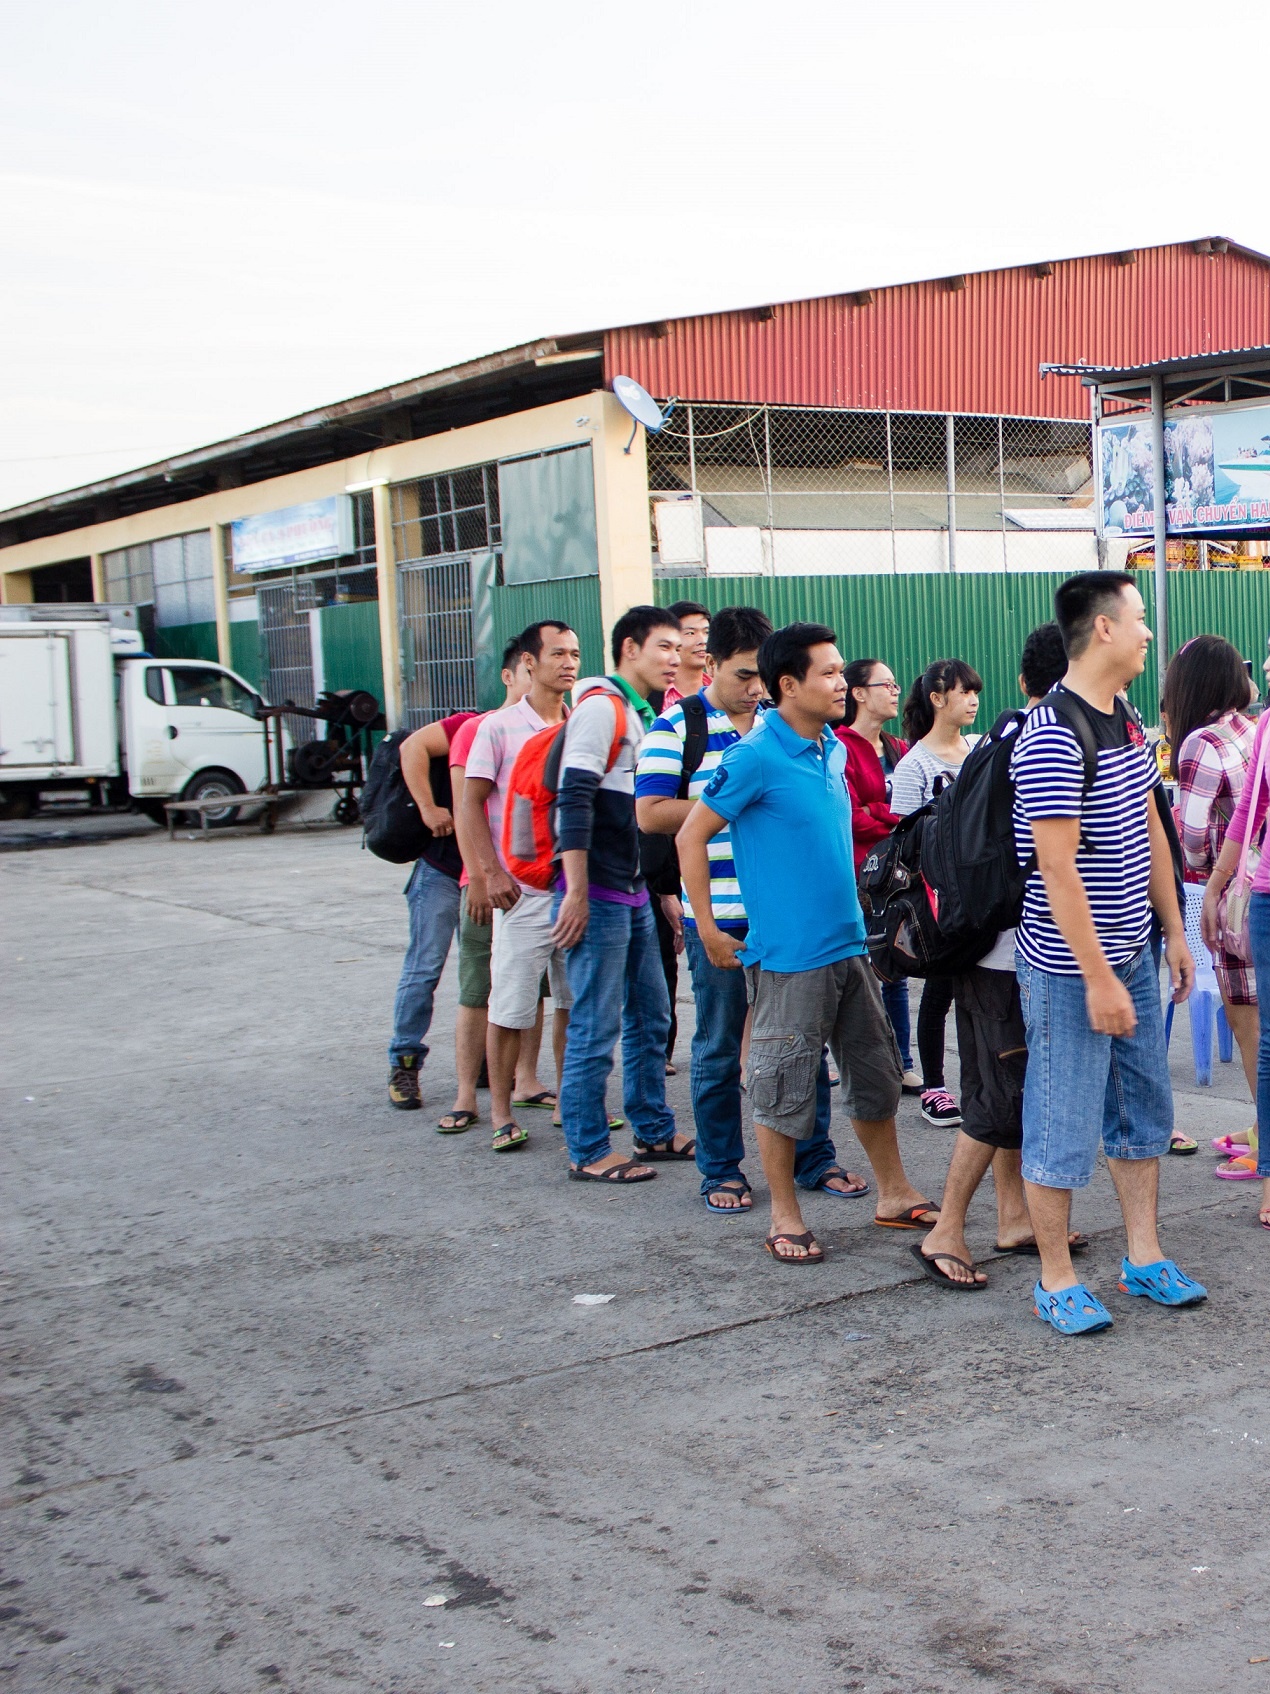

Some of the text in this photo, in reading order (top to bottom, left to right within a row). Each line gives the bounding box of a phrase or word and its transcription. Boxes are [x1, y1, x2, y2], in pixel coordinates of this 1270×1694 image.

[1124, 503, 1155, 529] ĐIỂM
[1168, 504, 1194, 527] VẬN
[1197, 496, 1247, 522] CHUYỂN
